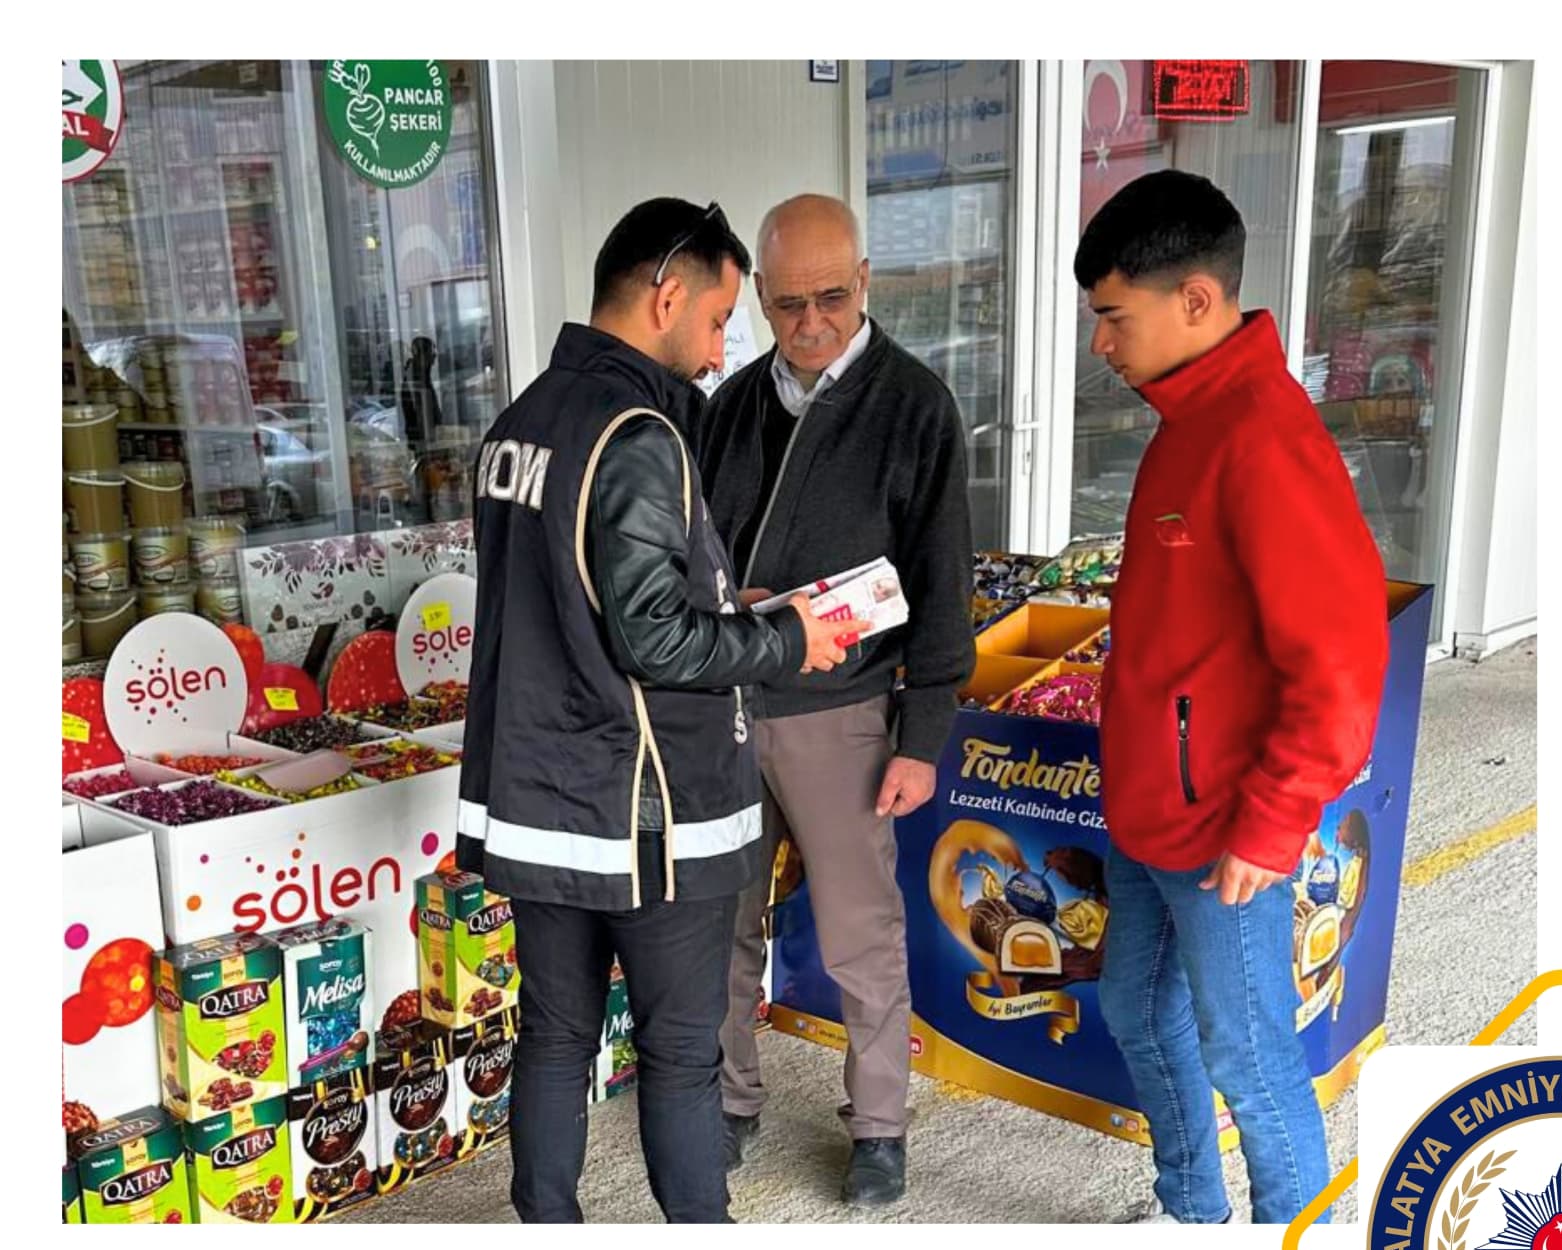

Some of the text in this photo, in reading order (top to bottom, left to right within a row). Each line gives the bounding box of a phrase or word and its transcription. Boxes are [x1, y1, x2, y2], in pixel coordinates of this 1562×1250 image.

[384, 88, 444, 105] PANCAR
[390, 110, 443, 132] ŞEKERİ
[344, 139, 441, 182] KULLANILMAKTADIR
[949, 789, 1003, 811] Lezzeti
[1004, 798, 1076, 825] Kalbinde
[469, 903, 513, 932] QATRA
[202, 983, 267, 1016] QATRA
[301, 972, 365, 1016] Melisa
[213, 1130, 275, 1166] QATRA
[103, 1164, 171, 1203] QATRA
